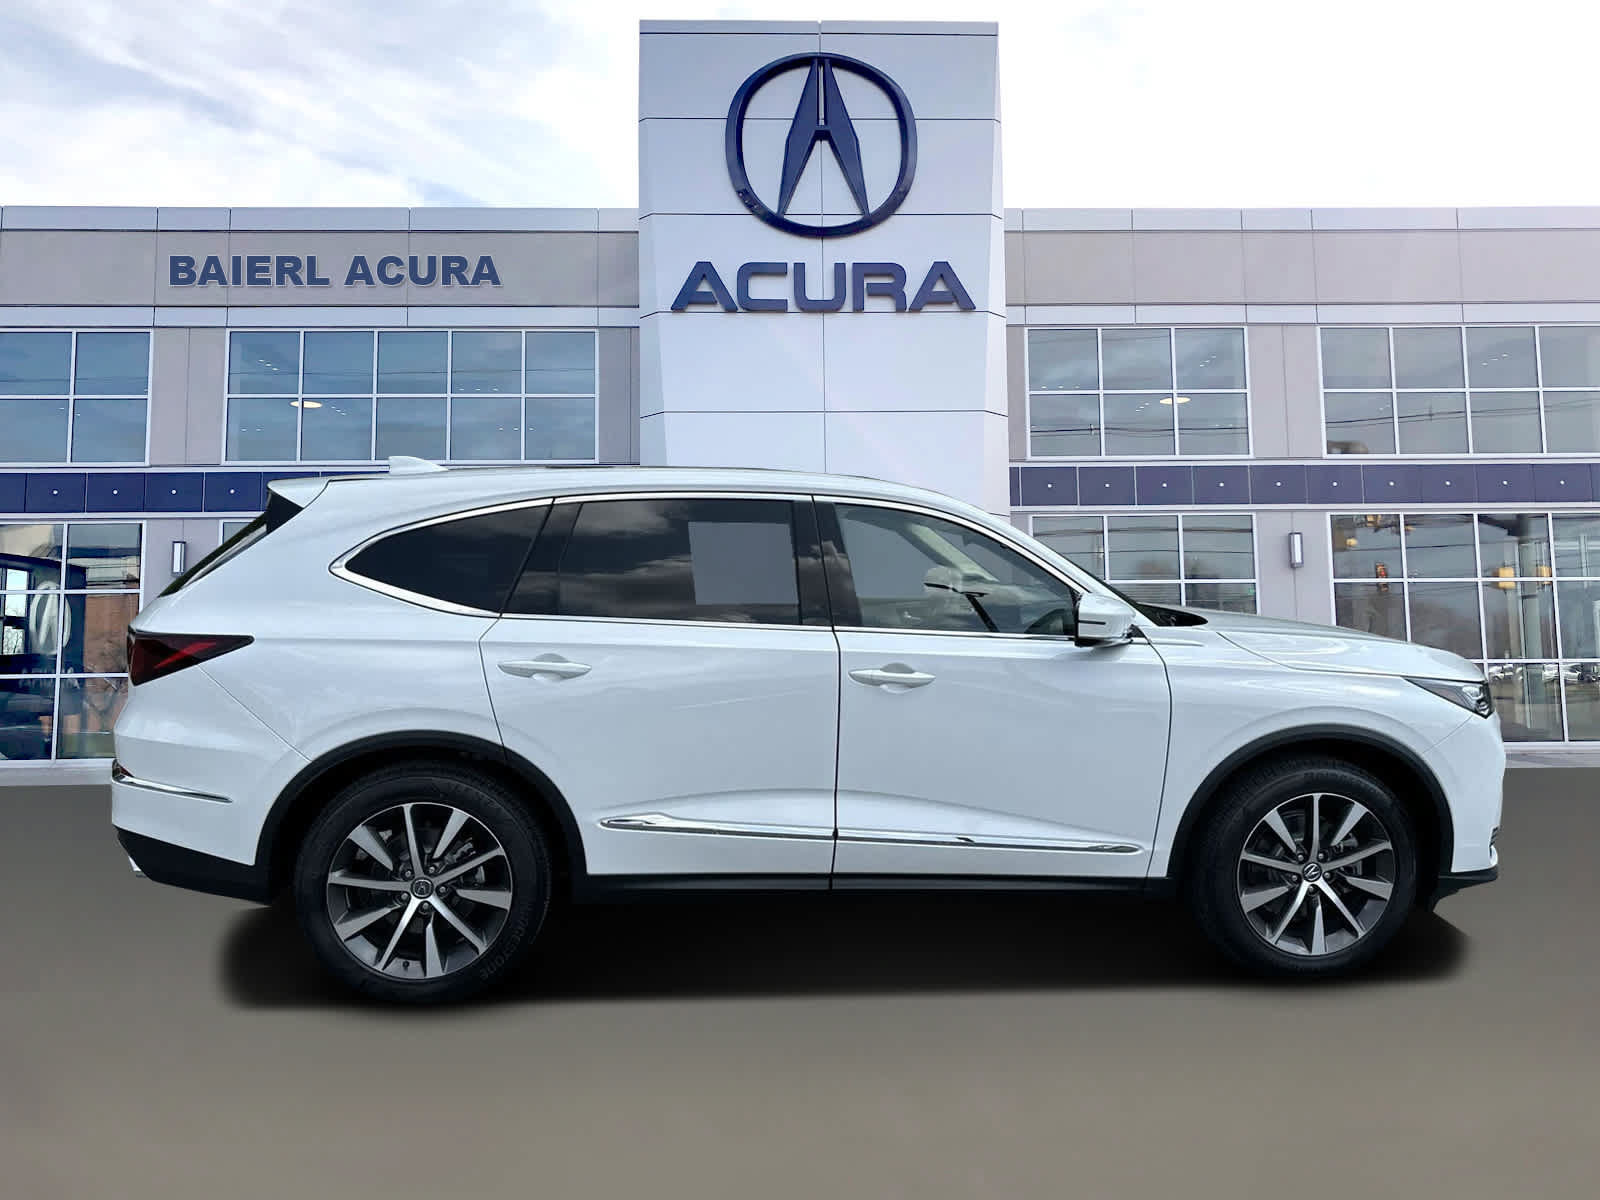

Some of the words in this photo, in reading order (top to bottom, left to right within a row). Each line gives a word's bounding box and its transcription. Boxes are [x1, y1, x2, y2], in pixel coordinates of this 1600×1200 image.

[168, 255, 331, 286] BAIERL
[344, 255, 501, 286] ACURA
[670, 261, 977, 312] ACURA
